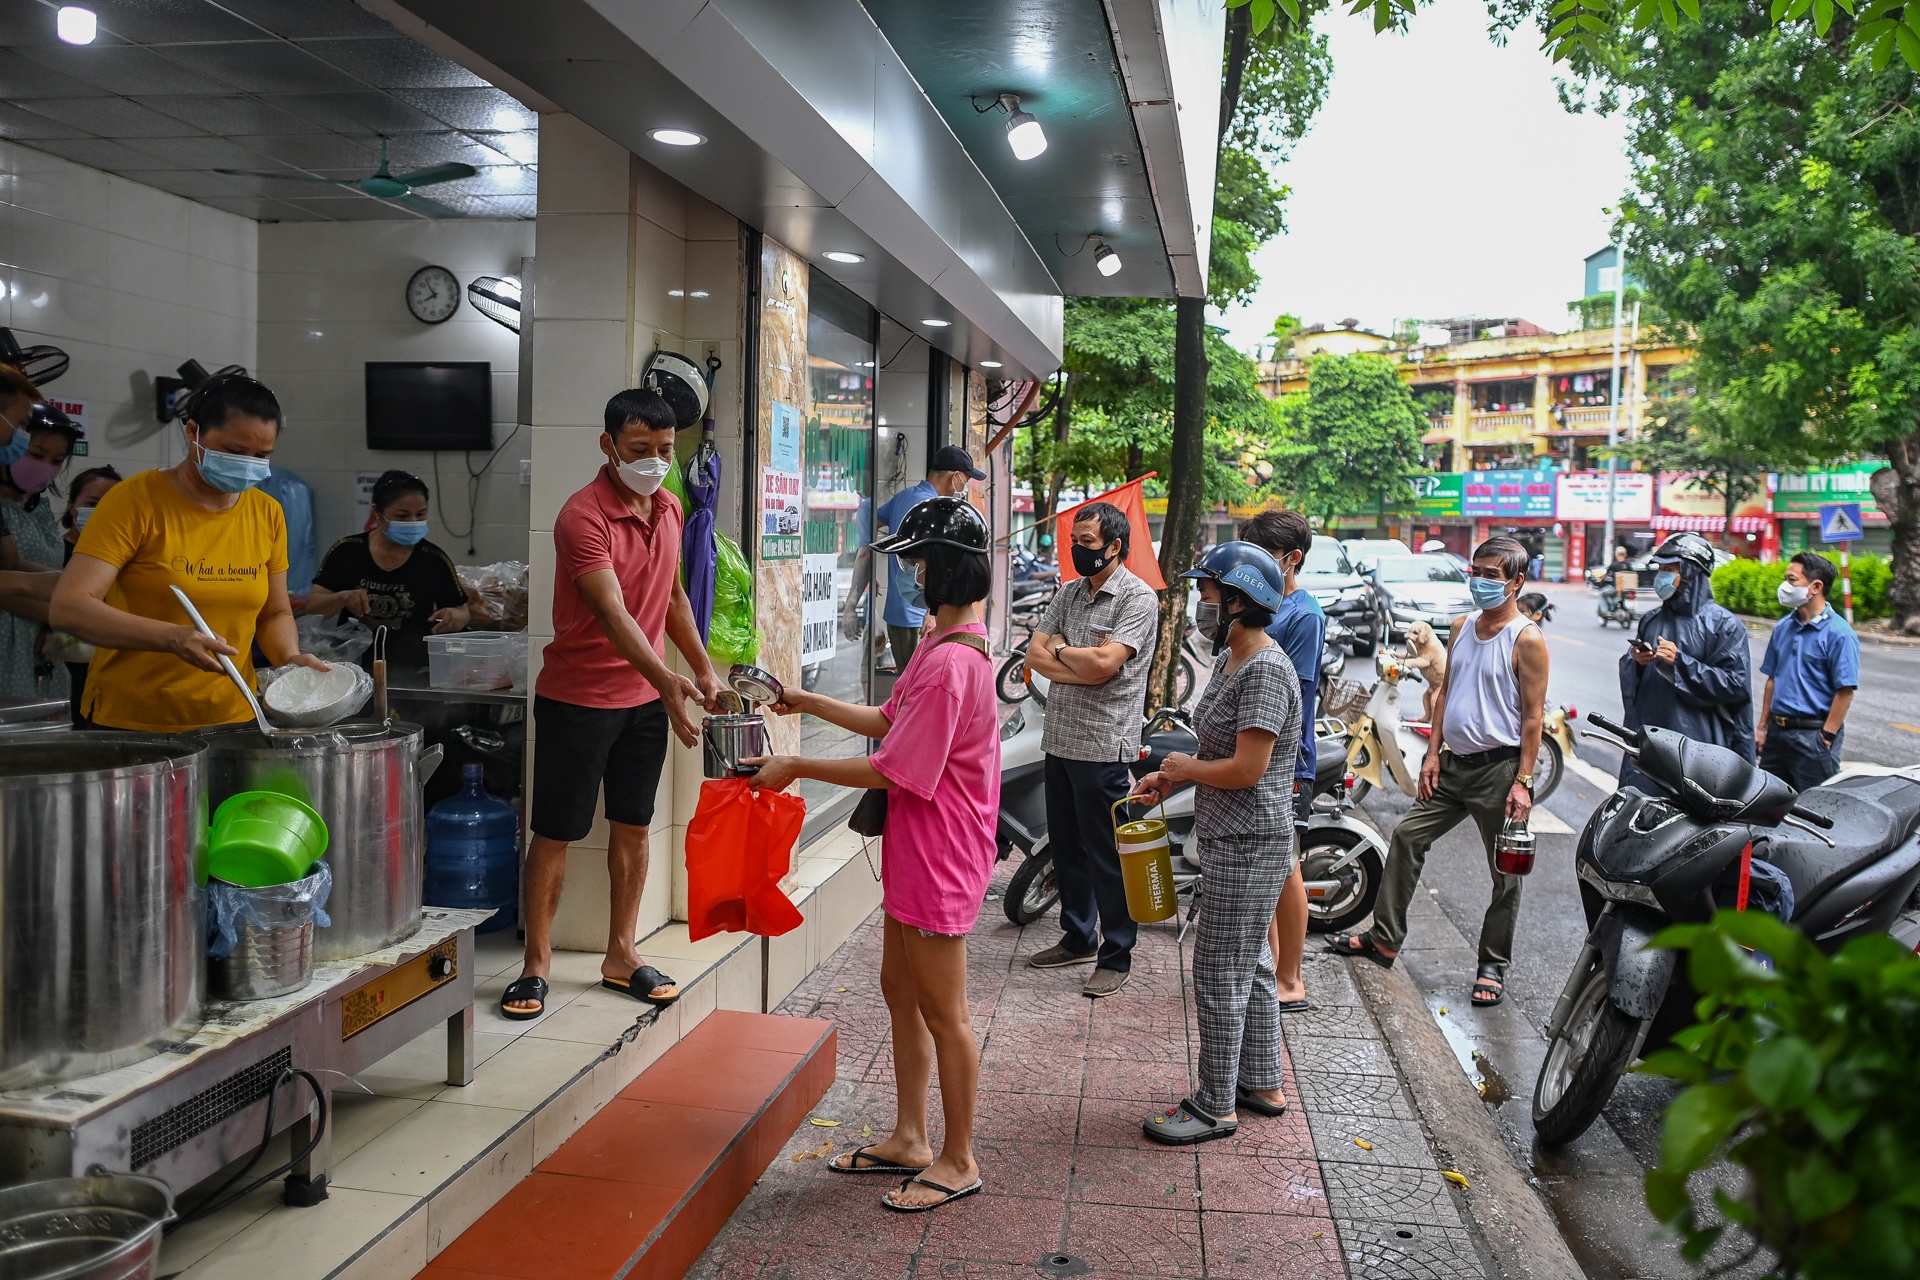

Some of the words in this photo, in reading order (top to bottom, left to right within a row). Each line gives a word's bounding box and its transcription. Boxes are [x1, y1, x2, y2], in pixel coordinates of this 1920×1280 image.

[65, 403, 83, 415] BAY
[766, 474, 774, 493] XE
[789, 478, 800, 496] BAY
[171, 556, 214, 576] What
[228, 564, 262, 580] beauty!
[360, 578, 406, 592] GIUSEPPE
[1235, 570, 1264, 591] UBER
[1149, 859, 1163, 911] THERMAL
